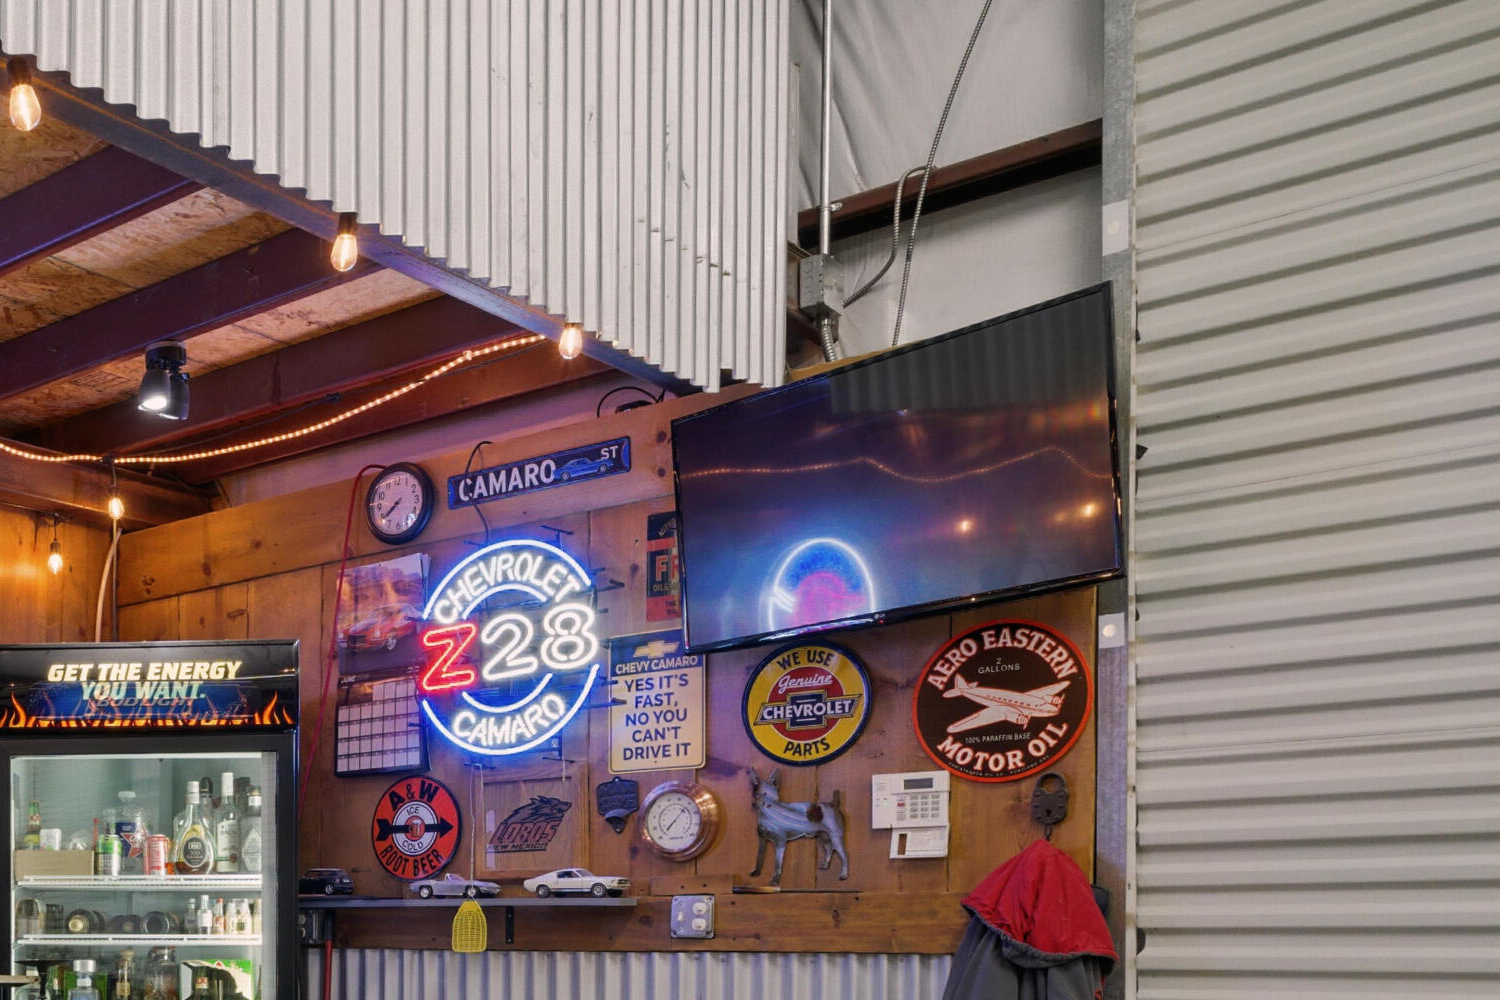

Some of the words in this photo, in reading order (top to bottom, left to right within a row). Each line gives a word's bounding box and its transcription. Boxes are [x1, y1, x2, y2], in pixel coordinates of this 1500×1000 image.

[458, 460, 556, 501] CAMARO
[600, 446, 618, 459] ST
[433, 552, 581, 624] CHEVROLET
[616, 660, 649, 674] CHEVY
[651, 656, 697, 670] CAMARO
[777, 652, 801, 670] WE
[807, 650, 834, 666] USE
[927, 638, 977, 690] AERO
[982, 628, 1078, 681] EASTERN
[996, 657, 1002, 665] 2
[48, 663, 94, 682] GET
[97, 662, 143, 682] THE
[147, 661, 242, 681] ENERGY
[978, 663, 1020, 674] GALLONS
[82, 681, 128, 699] YOU
[134, 680, 206, 699] WANT.
[625, 678, 654, 692] YES
[659, 674, 688, 689] IT'S
[778, 674, 832, 694] Genuine
[635, 692, 678, 708] FAST,
[626, 712, 649, 727] NO
[653, 708, 687, 724] YOU
[763, 701, 851, 719] CHEVROLET
[452, 694, 566, 746] CAMARO
[632, 726, 681, 742] CAN'T
[982, 734, 1013, 742] PARAFFIN
[1014, 732, 1031, 740] BASE
[623, 745, 671, 760] DRIVE
[676, 743, 690, 756] IT
[783, 738, 830, 756] PARTS
[936, 735, 1025, 772] MOTOR
[1028, 722, 1068, 757] OIL
[407, 806, 420, 816] ICE
[490, 821, 561, 844] LOBOS
[402, 839, 424, 851] COLD
[380, 845, 409, 875] ROOT
[413, 848, 445, 876] BEER
